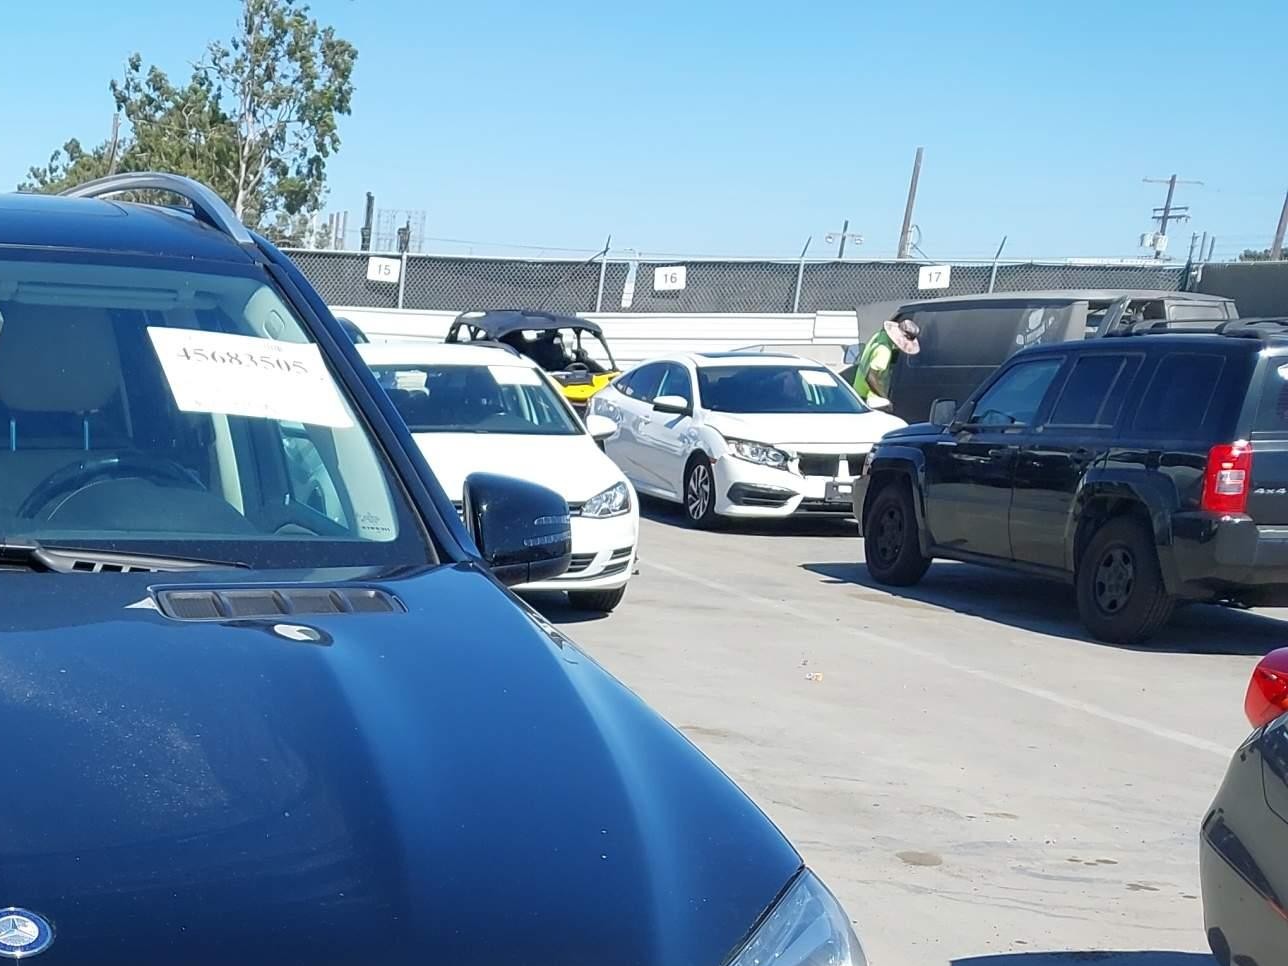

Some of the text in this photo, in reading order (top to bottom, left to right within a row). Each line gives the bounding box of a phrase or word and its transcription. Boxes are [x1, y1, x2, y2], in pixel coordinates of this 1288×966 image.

[377, 264, 391, 276] 15
[664, 273, 678, 284] 16
[928, 271, 942, 283] 17
